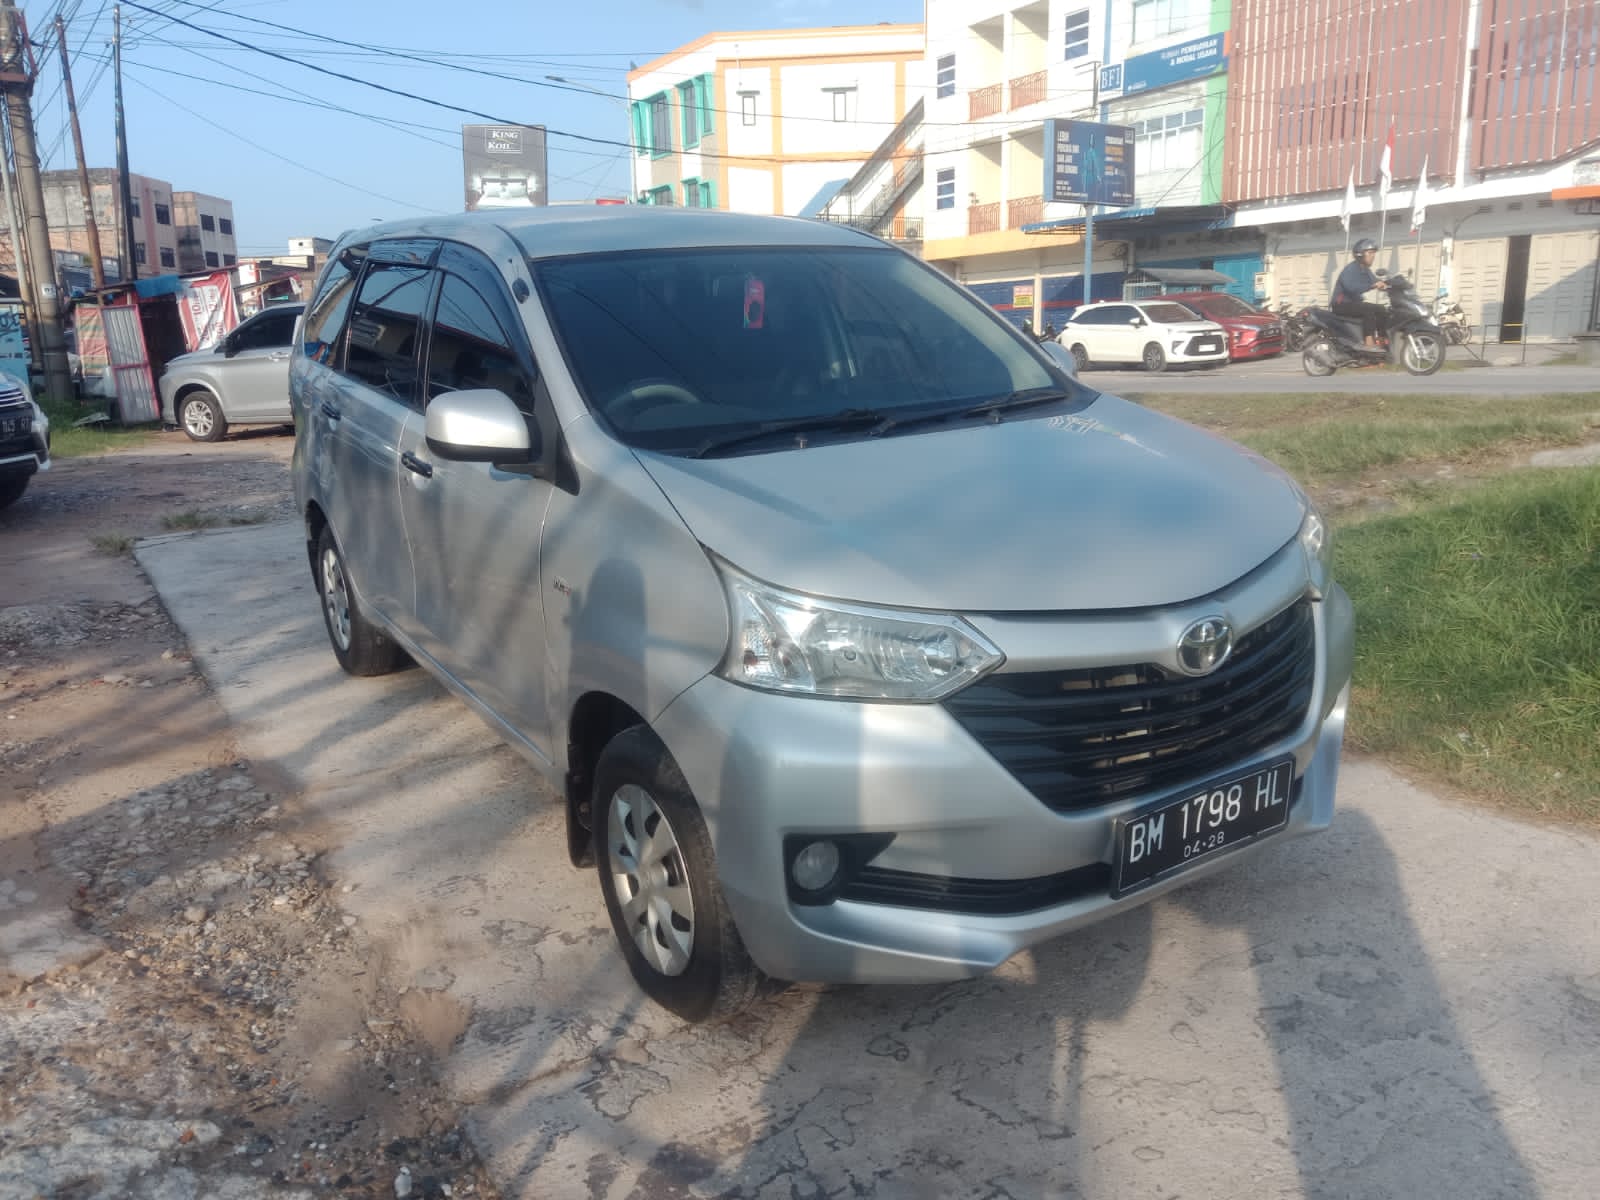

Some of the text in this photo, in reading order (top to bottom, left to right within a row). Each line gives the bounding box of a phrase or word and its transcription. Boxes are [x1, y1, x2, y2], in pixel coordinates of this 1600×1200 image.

[1101, 67, 1120, 89] BFI
[492, 130, 518, 139] KING
[488, 141, 511, 150] KOIL
[1130, 769, 1283, 863] BM 1798 HL
